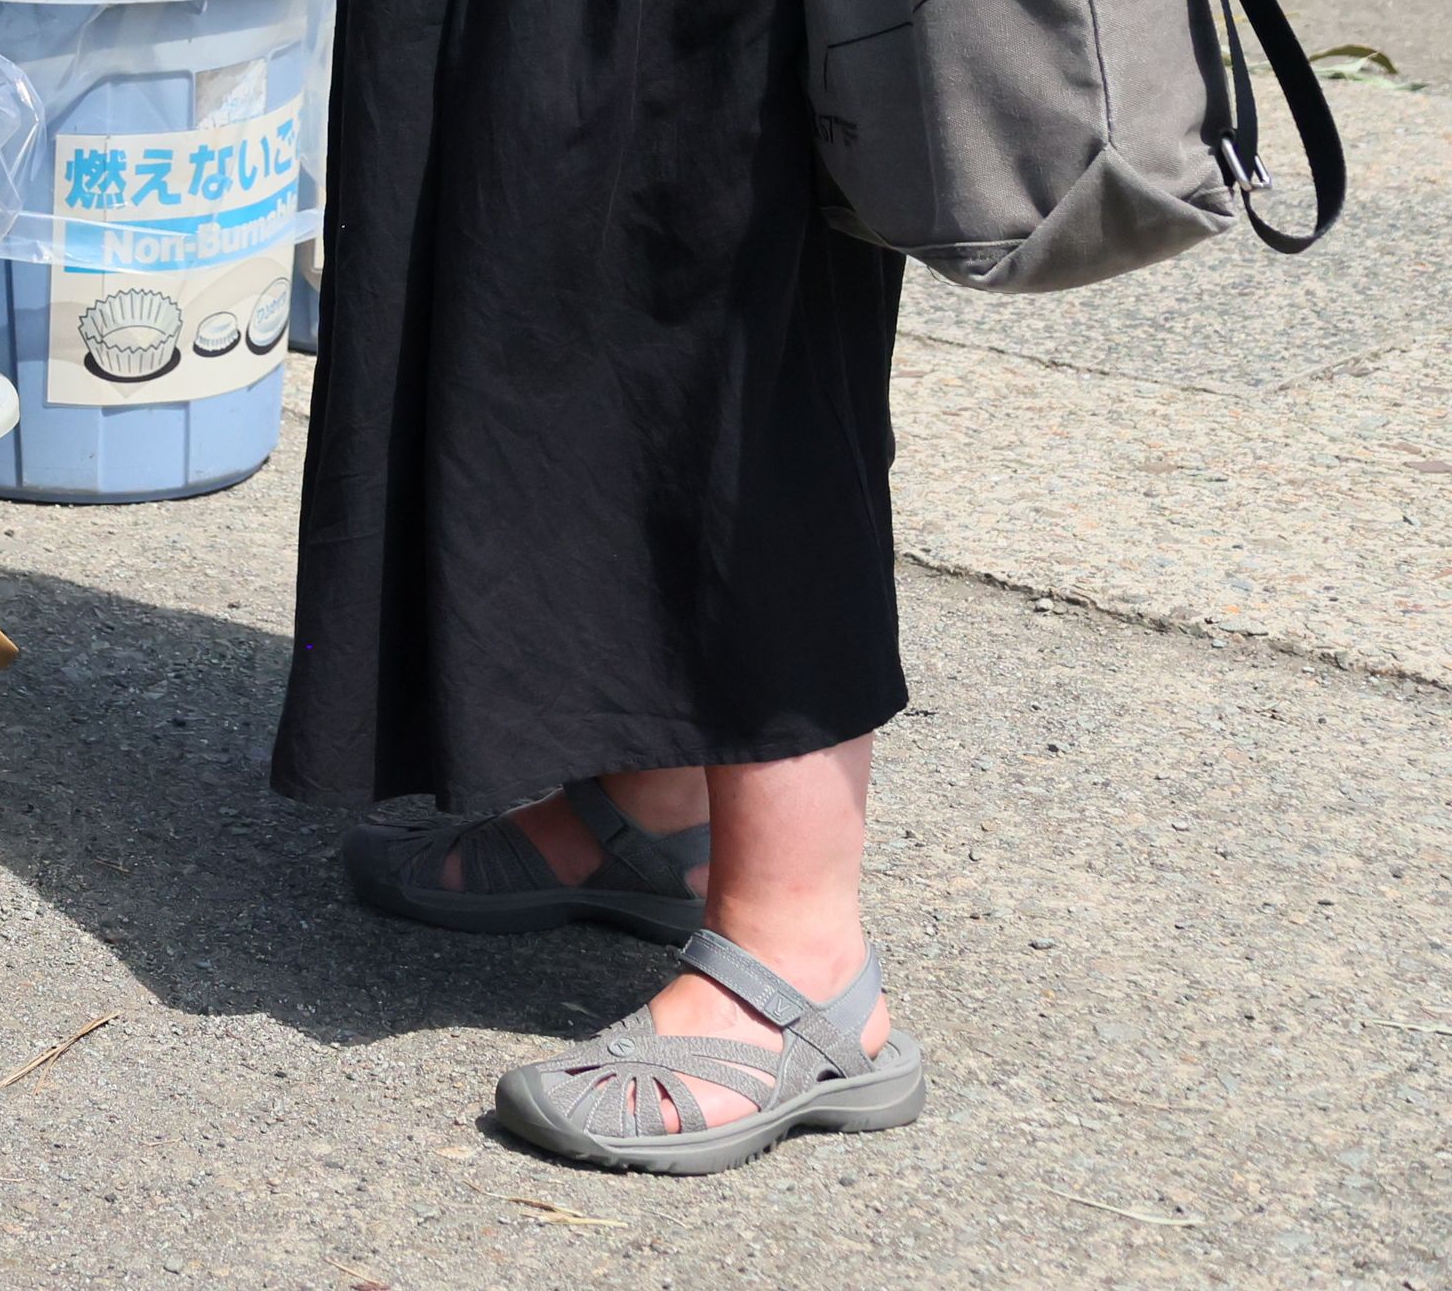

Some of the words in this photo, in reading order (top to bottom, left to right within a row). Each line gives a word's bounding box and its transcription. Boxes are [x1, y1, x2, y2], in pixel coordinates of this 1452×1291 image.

[65, 118, 301, 209] 燃えないご
